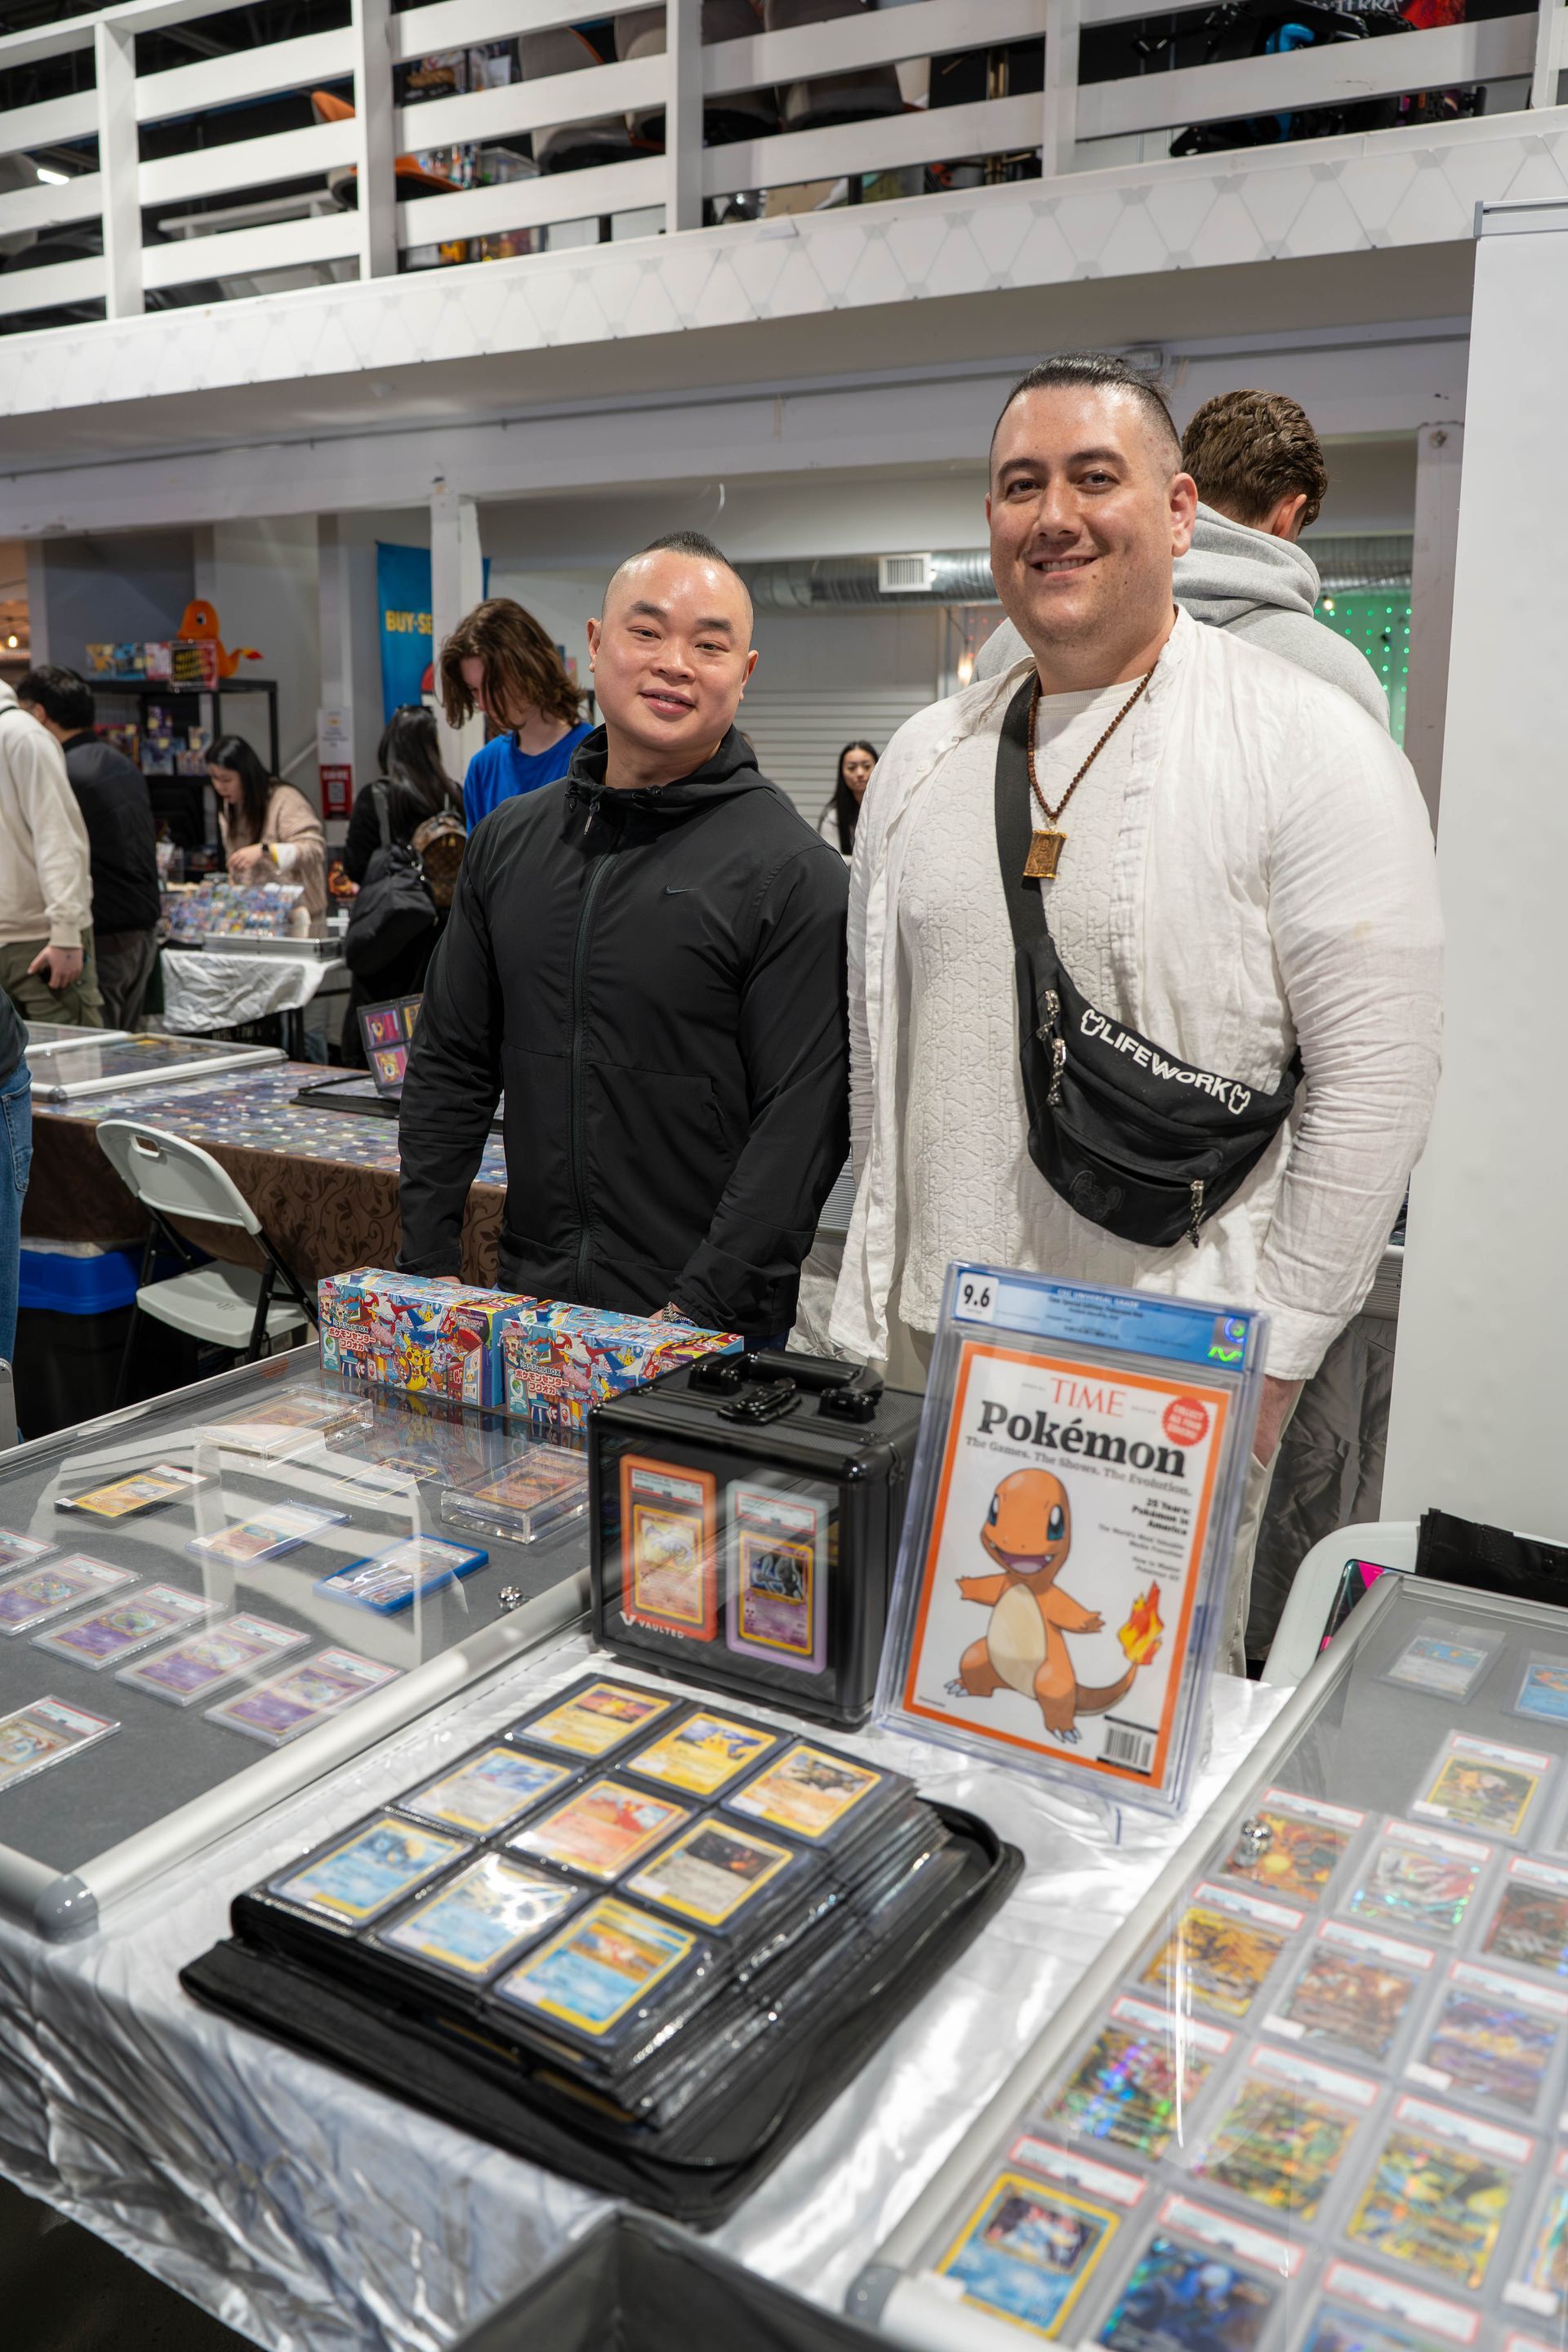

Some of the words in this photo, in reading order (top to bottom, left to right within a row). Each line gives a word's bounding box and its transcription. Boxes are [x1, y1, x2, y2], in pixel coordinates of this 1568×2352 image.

[1099, 1024, 1232, 1103] LIFEWORK
[964, 1284, 990, 1307] 9.6
[327, 1326, 376, 1344] ポケモンセンター
[340, 1338, 365, 1352] フクオカ
[514, 1368, 570, 1389] ポケモンセンター
[528, 1381, 557, 1396] フクオカ
[1050, 1377, 1127, 1418] TIME
[977, 1399, 1186, 1478] Pokémon
[966, 1436, 987, 1450] The
[989, 1440, 1031, 1459] Games.
[1034, 1451, 1056, 1467] The
[1059, 1457, 1101, 1477] Shows.
[1103, 1467, 1126, 1483] The
[1129, 1472, 1193, 1498] Evolution.
[1147, 1519, 1187, 1536] America
[639, 1619, 685, 1640] VAULTED
